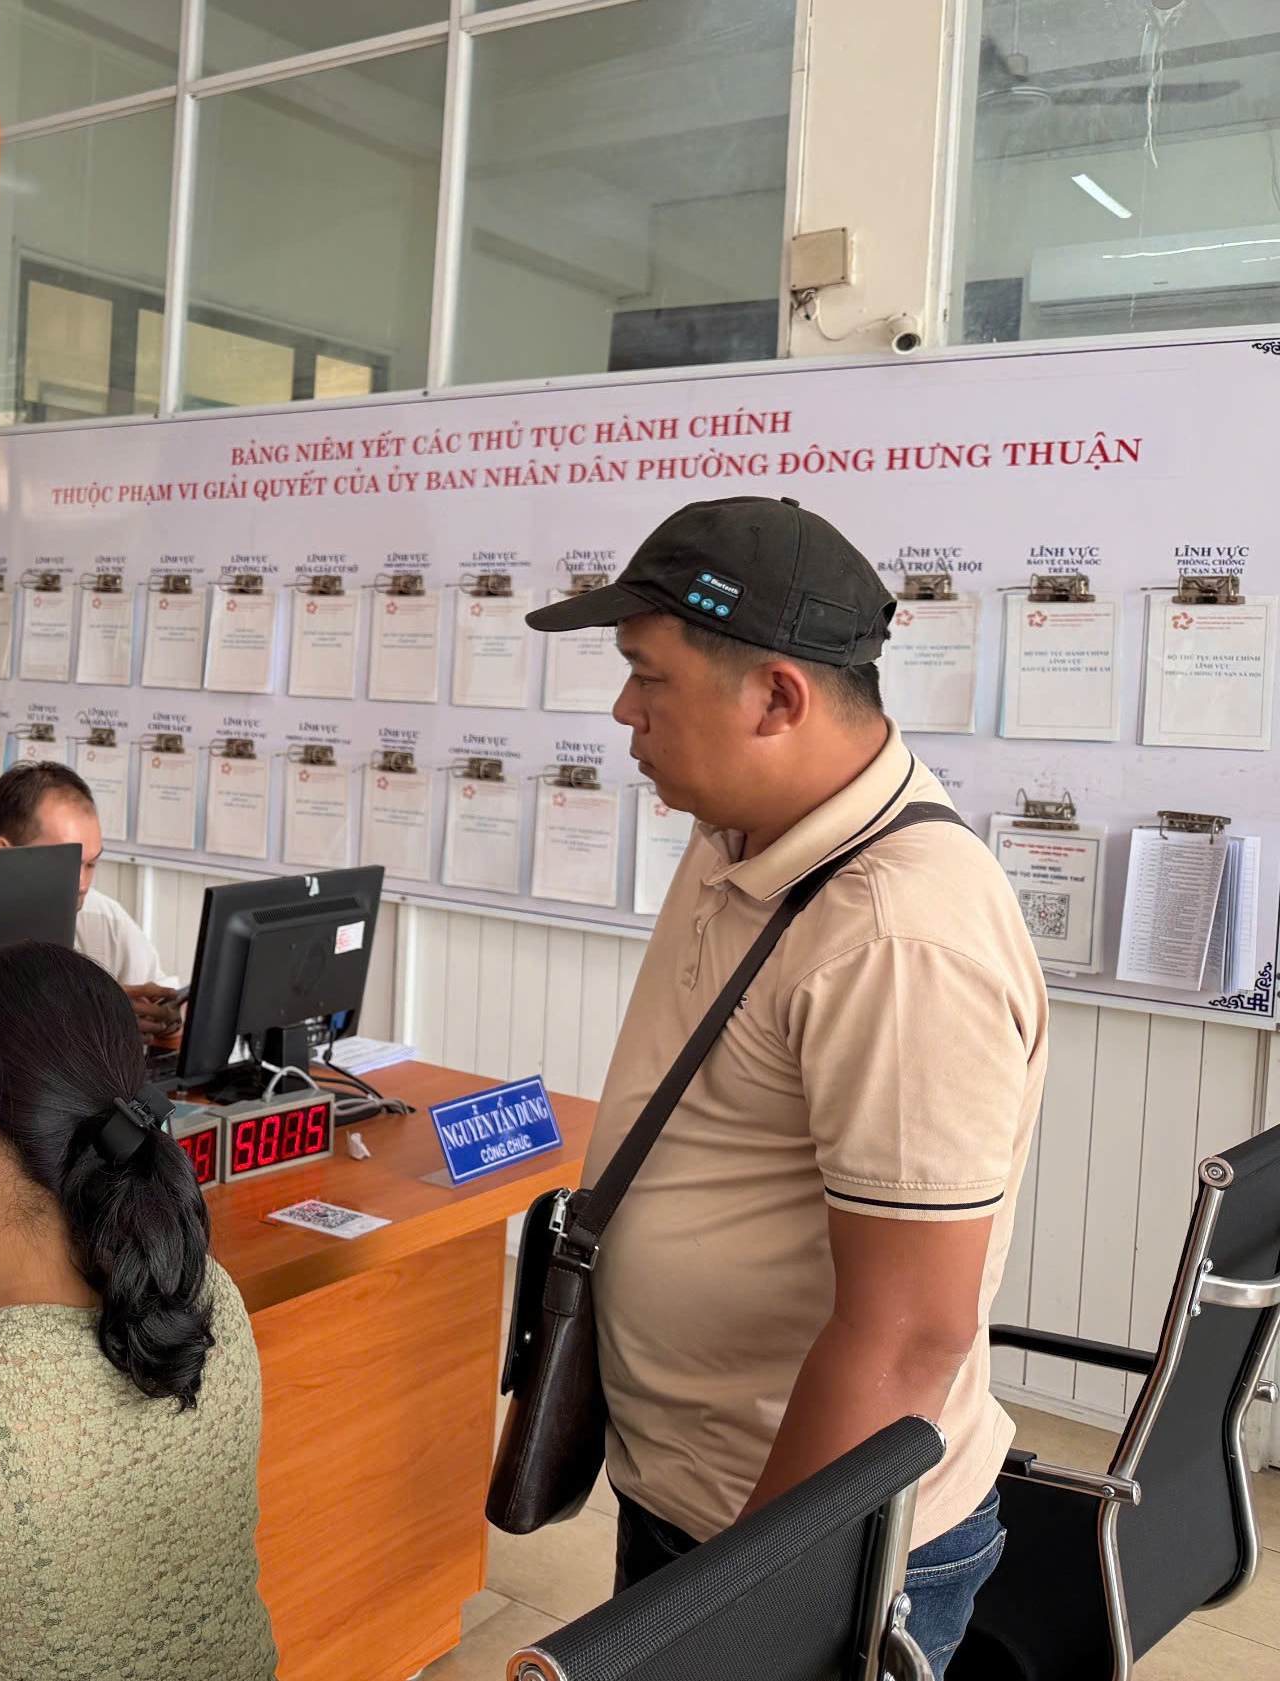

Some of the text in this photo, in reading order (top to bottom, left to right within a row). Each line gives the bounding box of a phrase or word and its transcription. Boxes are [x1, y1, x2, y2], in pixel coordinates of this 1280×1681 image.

[230, 407, 793, 466] BẢNG NIÊM YẾT CÁC THỦ TỤC HÀNH CHÍNH
[51, 431, 1144, 508] THUỘC PHẠM VI GIẢI QUYẾT CỦA ỦY BAN NHÂN DÂN PHƯỜNG ĐÔNG HƯNG THUẬN
[899, 546, 963, 560] LĨNH VỰC
[1030, 545, 1101, 559] LĨNH VỰC
[1174, 544, 1250, 559] LĨNH VỰC
[958, 561, 983, 573] HỘI
[1212, 558, 1245, 566] CHỐNG
[556, 740, 606, 754] LĨNH VỰC
[441, 1095, 549, 1150] NGUYỄN TẤN DŨNG
[233, 1104, 326, 1172] 5015
[480, 1134, 533, 1164] CÔNG CHỨC
